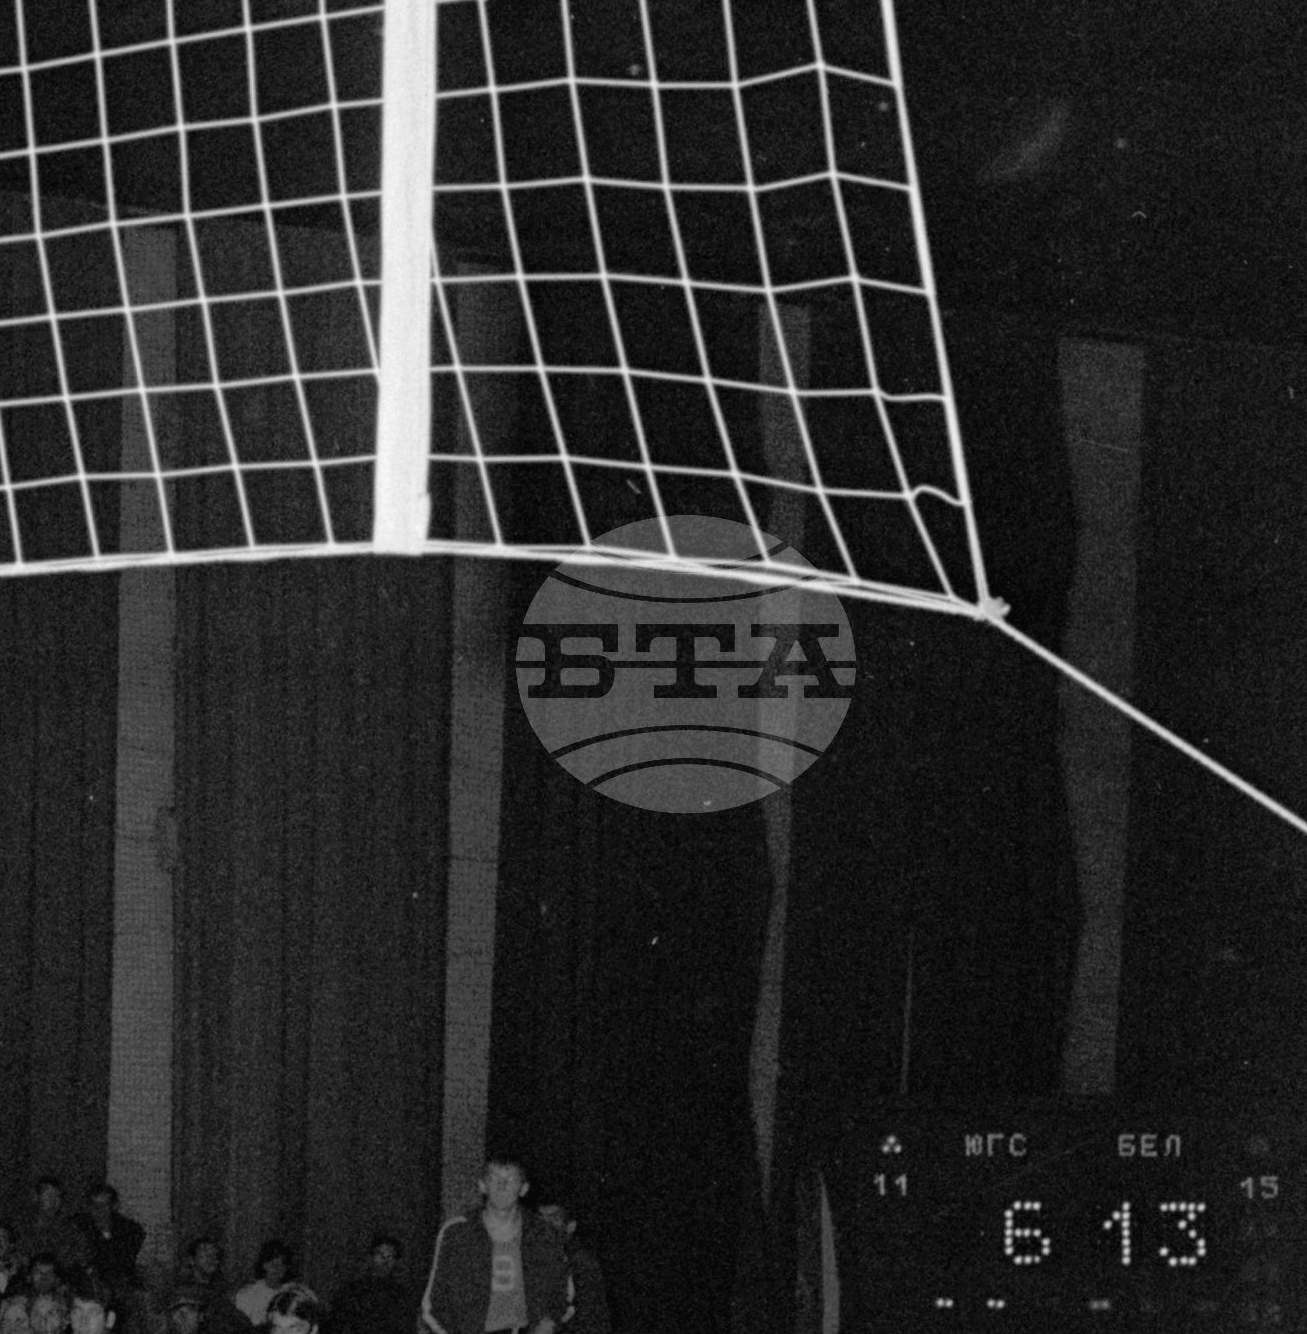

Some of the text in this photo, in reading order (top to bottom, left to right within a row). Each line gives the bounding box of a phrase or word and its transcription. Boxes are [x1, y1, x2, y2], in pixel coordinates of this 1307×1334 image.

[964, 1133, 1182, 1158] ЮГС БЕЛ
[873, 1173, 1280, 1199] 11 15
[1003, 1200, 1207, 1267] 6 13
